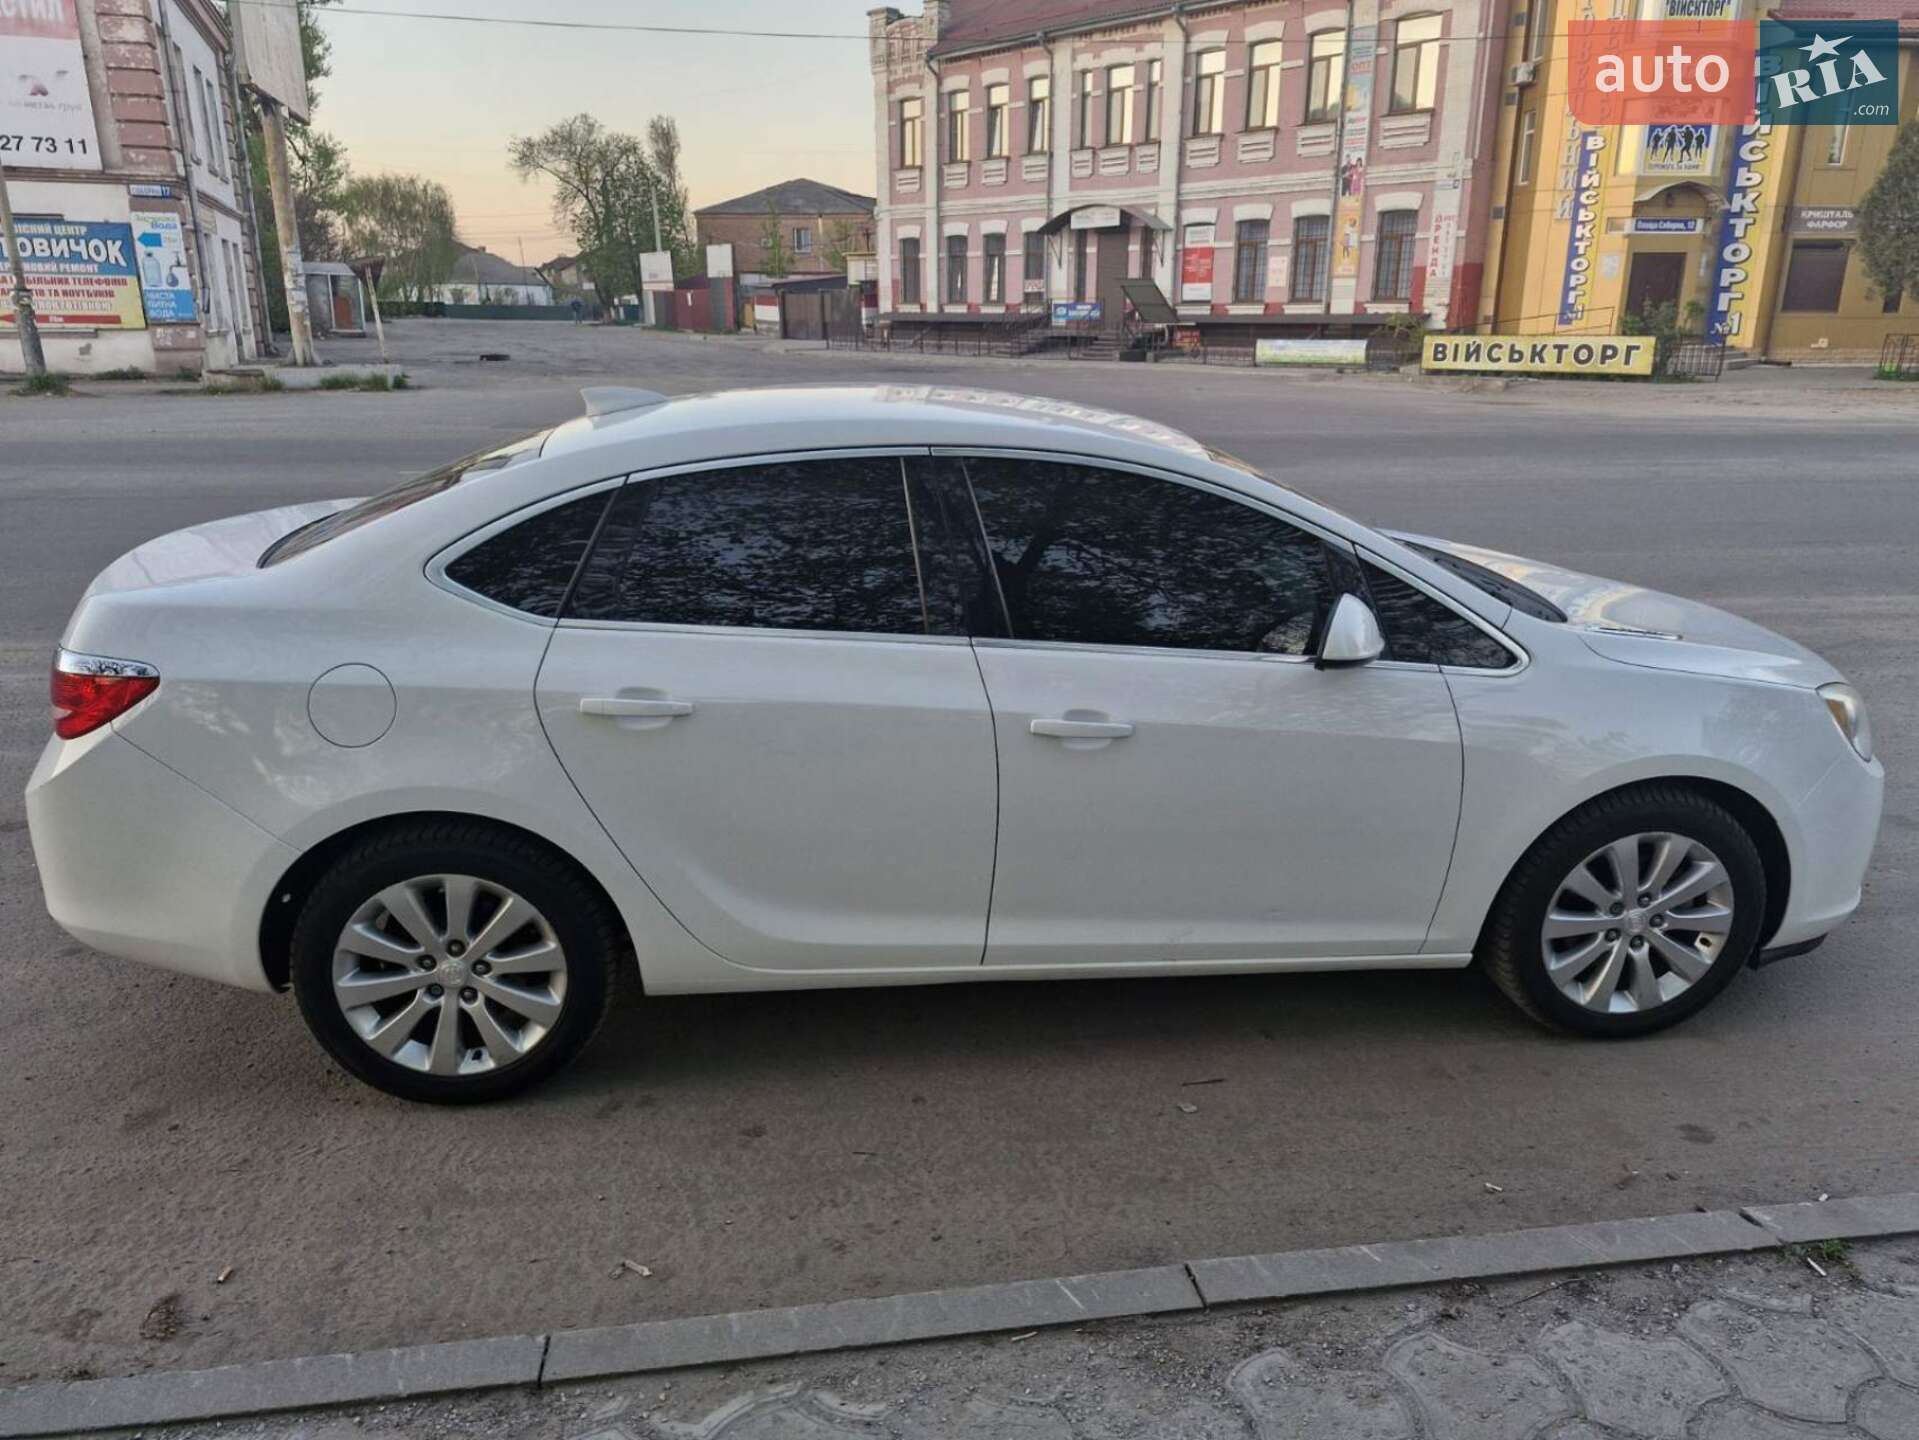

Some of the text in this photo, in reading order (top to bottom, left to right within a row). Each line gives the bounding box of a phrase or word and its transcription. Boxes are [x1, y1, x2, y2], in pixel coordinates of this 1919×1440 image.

[0, 135, 87, 155] 27 73 11
[1567, 135, 1607, 305] ВІЙСЬКТОРГ
[1432, 341, 1641, 366] ВІЙСЬКТОРГ
